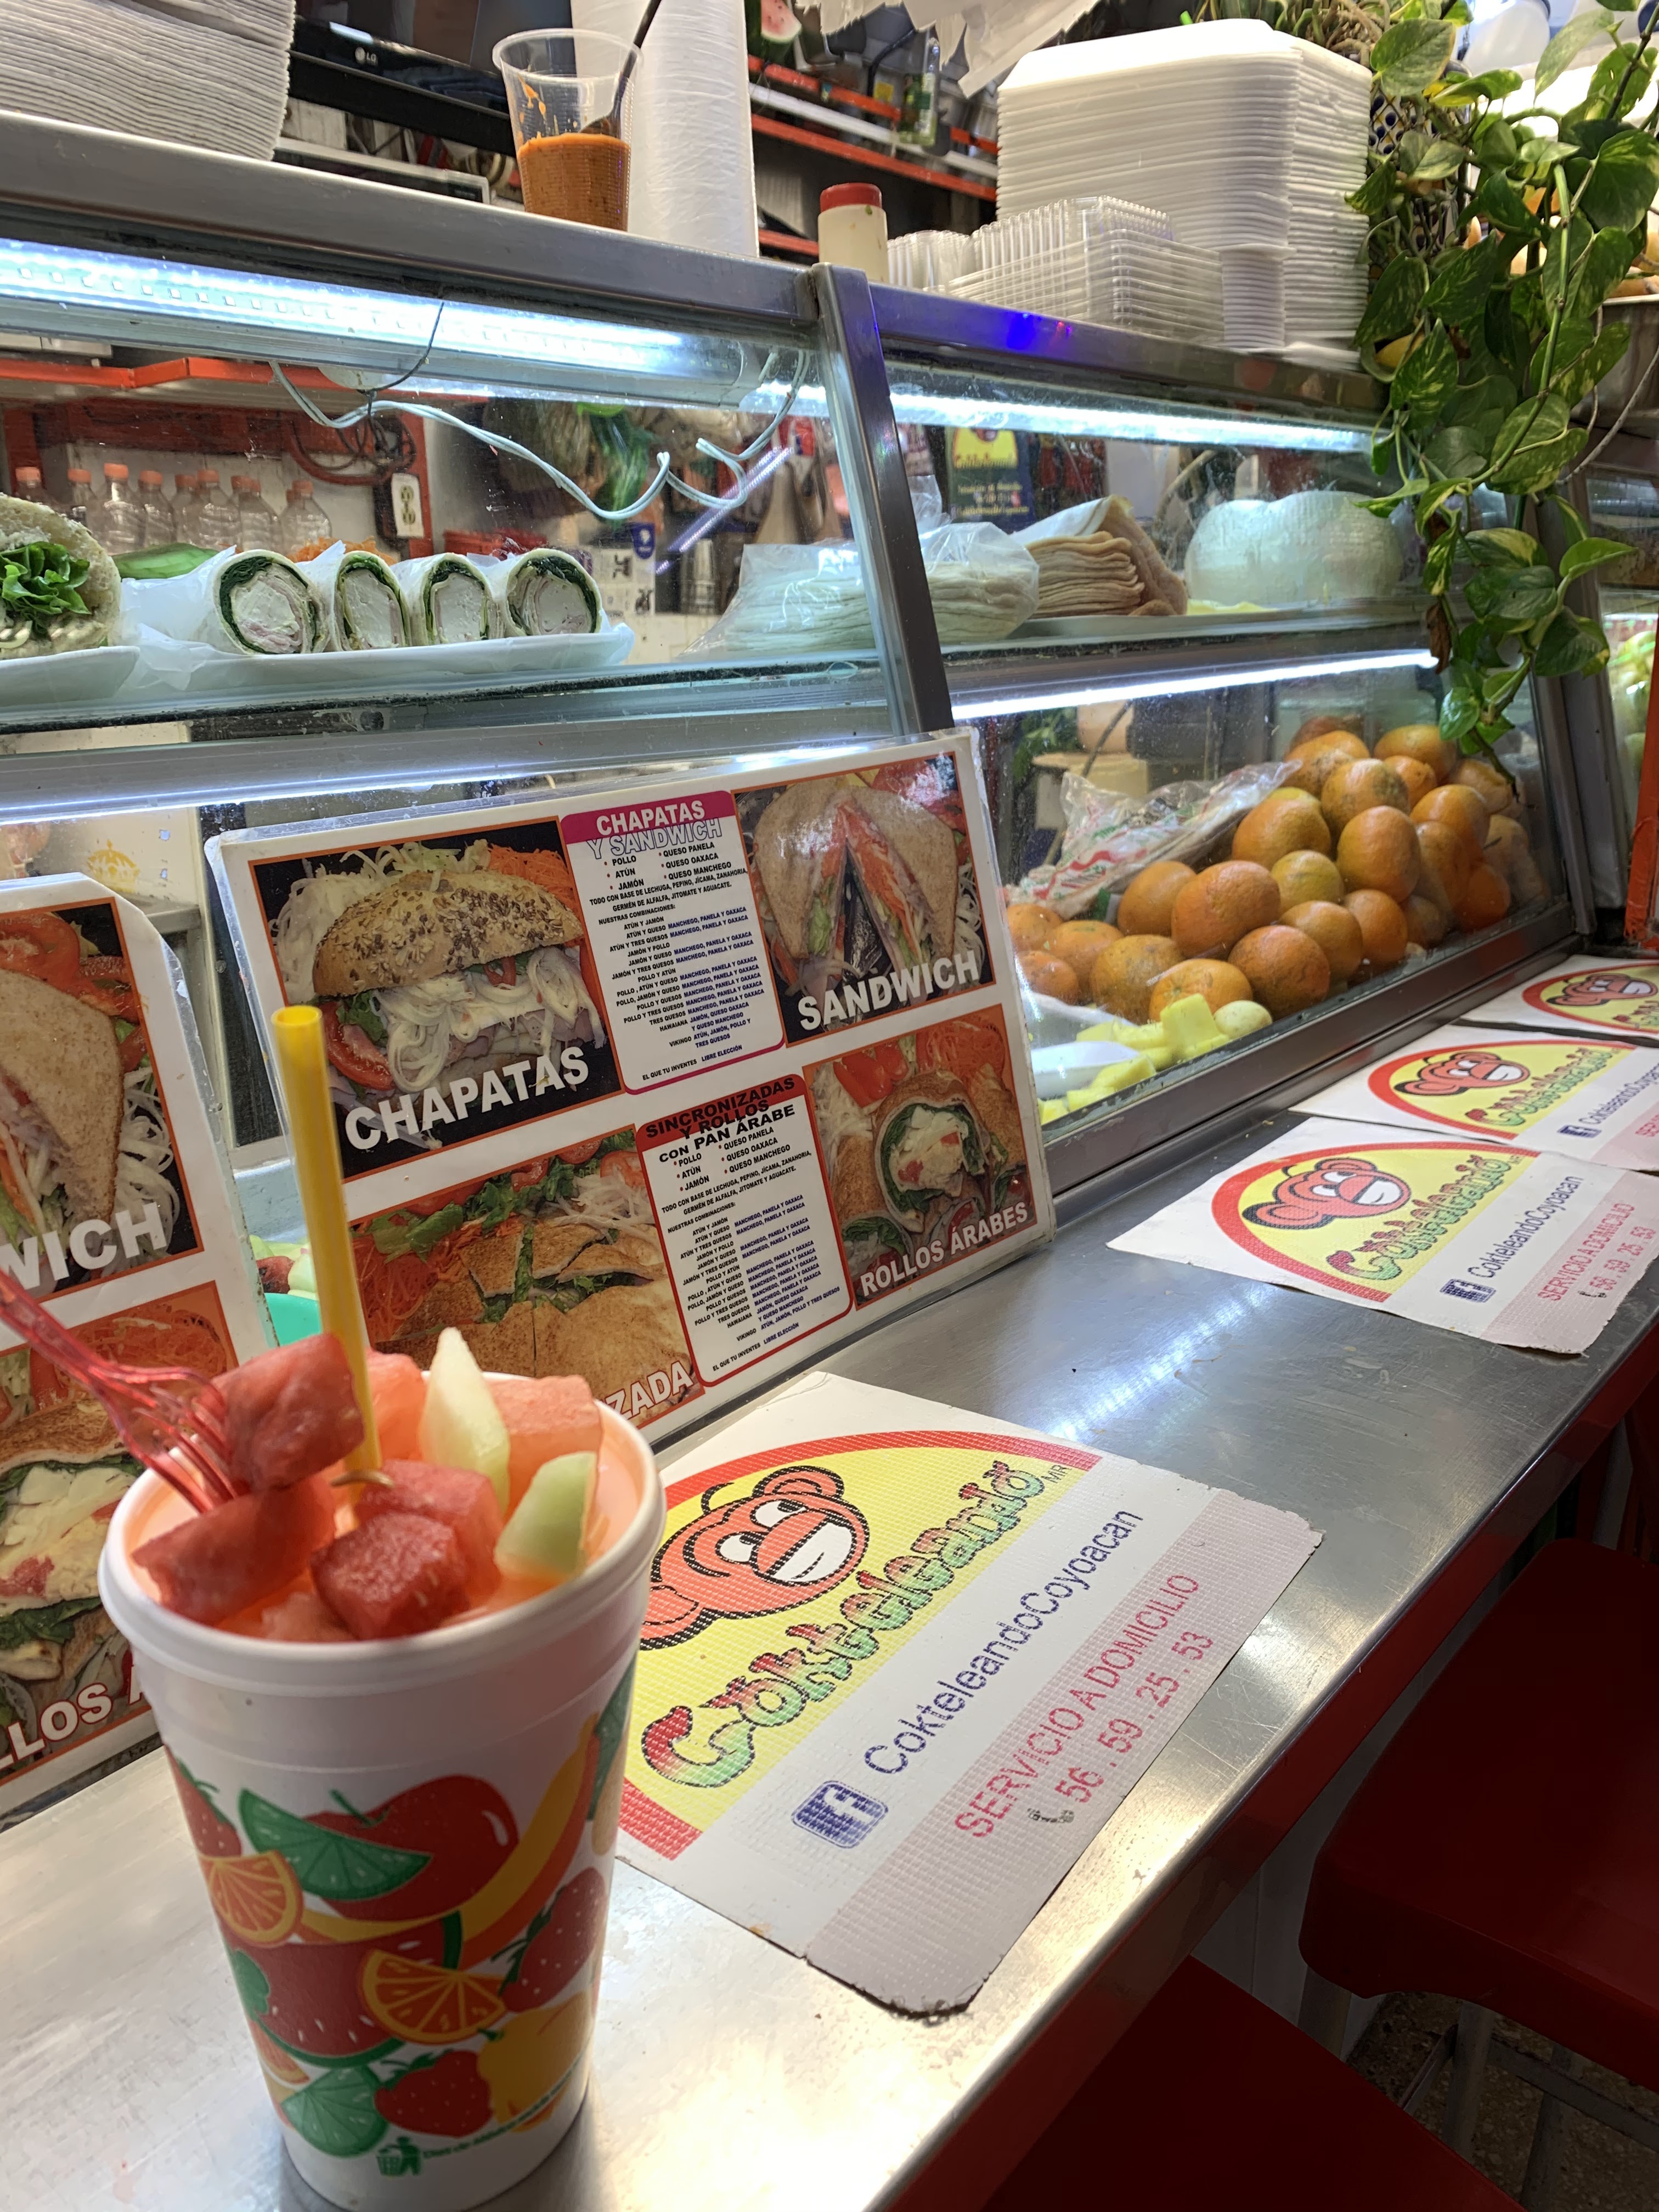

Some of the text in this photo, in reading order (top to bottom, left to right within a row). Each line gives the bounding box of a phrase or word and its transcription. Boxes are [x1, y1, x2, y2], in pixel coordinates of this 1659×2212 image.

[596, 800, 704, 835] CHAPATAS
[586, 817, 723, 859] Y SANDWICH
[663, 842, 714, 857] QUESO PANELA
[612, 855, 636, 866] POLLO
[616, 867, 635, 878] ATÚN
[665, 853, 718, 868] QUESO OAXACA
[668, 861, 731, 879] QUESO MANCHEGO
[589, 896, 605, 905] TODO
[606, 894, 619, 902] CON
[619, 890, 635, 899] BASE
[644, 883, 672, 894] LECHUGA,
[672, 879, 693, 888] PEPINO,
[695, 874, 716, 883] JÍCAMA,
[716, 867, 748, 879] ZANAHORIA,
[612, 900, 636, 911] GERMÉN
[646, 894, 670, 905] ALFALFA,
[671, 888, 697, 899] JITOMATE
[703, 881, 731, 892] AGUACATE.
[618, 878, 644, 890] JAMÓN
[598, 904, 675, 924] NUESTRAS COMBINACIONES:
[645, 916, 664, 925] JAMÓN
[647, 925, 665, 933] QUESO
[668, 917, 699, 929] MANCHEGO,
[699, 912, 720, 921] PANELA
[725, 906, 746, 915] OAXACA
[610, 943, 624, 952] ATÚN
[646, 933, 668, 943] QUESOS
[669, 926, 701, 938] MANCHEGO,
[702, 921, 722, 930] PANELA
[727, 915, 748, 924] OAXACA
[627, 947, 646, 957] JAMÓN
[652, 942, 670, 951] POLLO
[798, 950, 980, 1031] SANDWICH
[649, 1017, 663, 1025] TRES
[664, 1011, 686, 1021] QUESOS
[687, 1002, 718, 1014] MANCHEGO,
[719, 996, 738, 1005] PANELA
[744, 989, 764, 998] OAXACA
[659, 1001, 749, 1031] HAWAIANA JAMÓN, QUESO OAXACA
[696, 1020, 714, 1029] QUESO
[714, 1012, 743, 1024] MANCHEGO
[669, 1036, 691, 1047] VIKINGO
[693, 1031, 709, 1040] ATÚN,
[710, 1025, 729, 1035] JAMÓN,
[730, 1019, 746, 1029] POLLO
[695, 1033, 730, 1048] TRES QUESOS
[671, 1059, 697, 1071] INVENTES
[701, 1052, 716, 1062] LIBRE
[717, 1045, 742, 1057] ELECCIÓN
[345, 1046, 590, 1151] CHAPATAS
[645, 1077, 795, 1138] SINCRONIZADAS
[659, 1104, 795, 1162] CON PAN ÁRABE
[679, 1100, 769, 1140] Y ROLLOS
[724, 1126, 774, 1149] QUESO PANELA
[726, 1137, 777, 1161] QUESO OAXACA
[678, 1153, 701, 1166] POLLO
[682, 1165, 701, 1178] ATÚN
[729, 1144, 790, 1172] QUESO MANCHEGO
[661, 1203, 676, 1213] TODO
[678, 1198, 690, 1206] CON
[690, 1192, 704, 1201] BASE
[713, 1178, 739, 1192] LECHUGA,
[740, 1170, 760, 1182] PEPINO,
[760, 1162, 781, 1173] JÍCAMA,
[781, 1150, 811, 1165] ZANAHORIA,
[683, 1201, 706, 1215] GERMÉN
[715, 1189, 738, 1202] ALFALFA,
[738, 1178, 763, 1192] JITOMATE
[769, 1165, 796, 1180] AGUACATE.
[685, 1175, 709, 1190] JAMÓN
[667, 1201, 735, 1233] NUESTRAS COMBINACIONES:
[1468, 1176, 1584, 1278] CokteleandoCoyoacan
[860, 1201, 1028, 1297] ROLLOS ÁRABES
[1537, 1255, 1592, 1301] SERVICIO
[736, 1328, 756, 1341] VIKINGO
[761, 1320, 774, 1330] ATÚN,
[775, 1311, 792, 1322] JAMÓN,
[792, 1303, 806, 1313] POLLO
[810, 1295, 822, 1304] TRES
[822, 1286, 839, 1298] QUESOS
[719, 1358, 730, 1367] QUE
[737, 1342, 760, 1358] INVENTES
[763, 1334, 777, 1344] LIBRE
[777, 1322, 799, 1337] ELECCIÓN
[641, 1460, 1073, 1789] Cokteleando MR
[864, 1510, 1144, 1775] CokteleandoCoyoacan
[955, 1575, 1199, 1838] SERVICIO A DOMICILIO
[1054, 1631, 1214, 1803] 56 59 25 53
